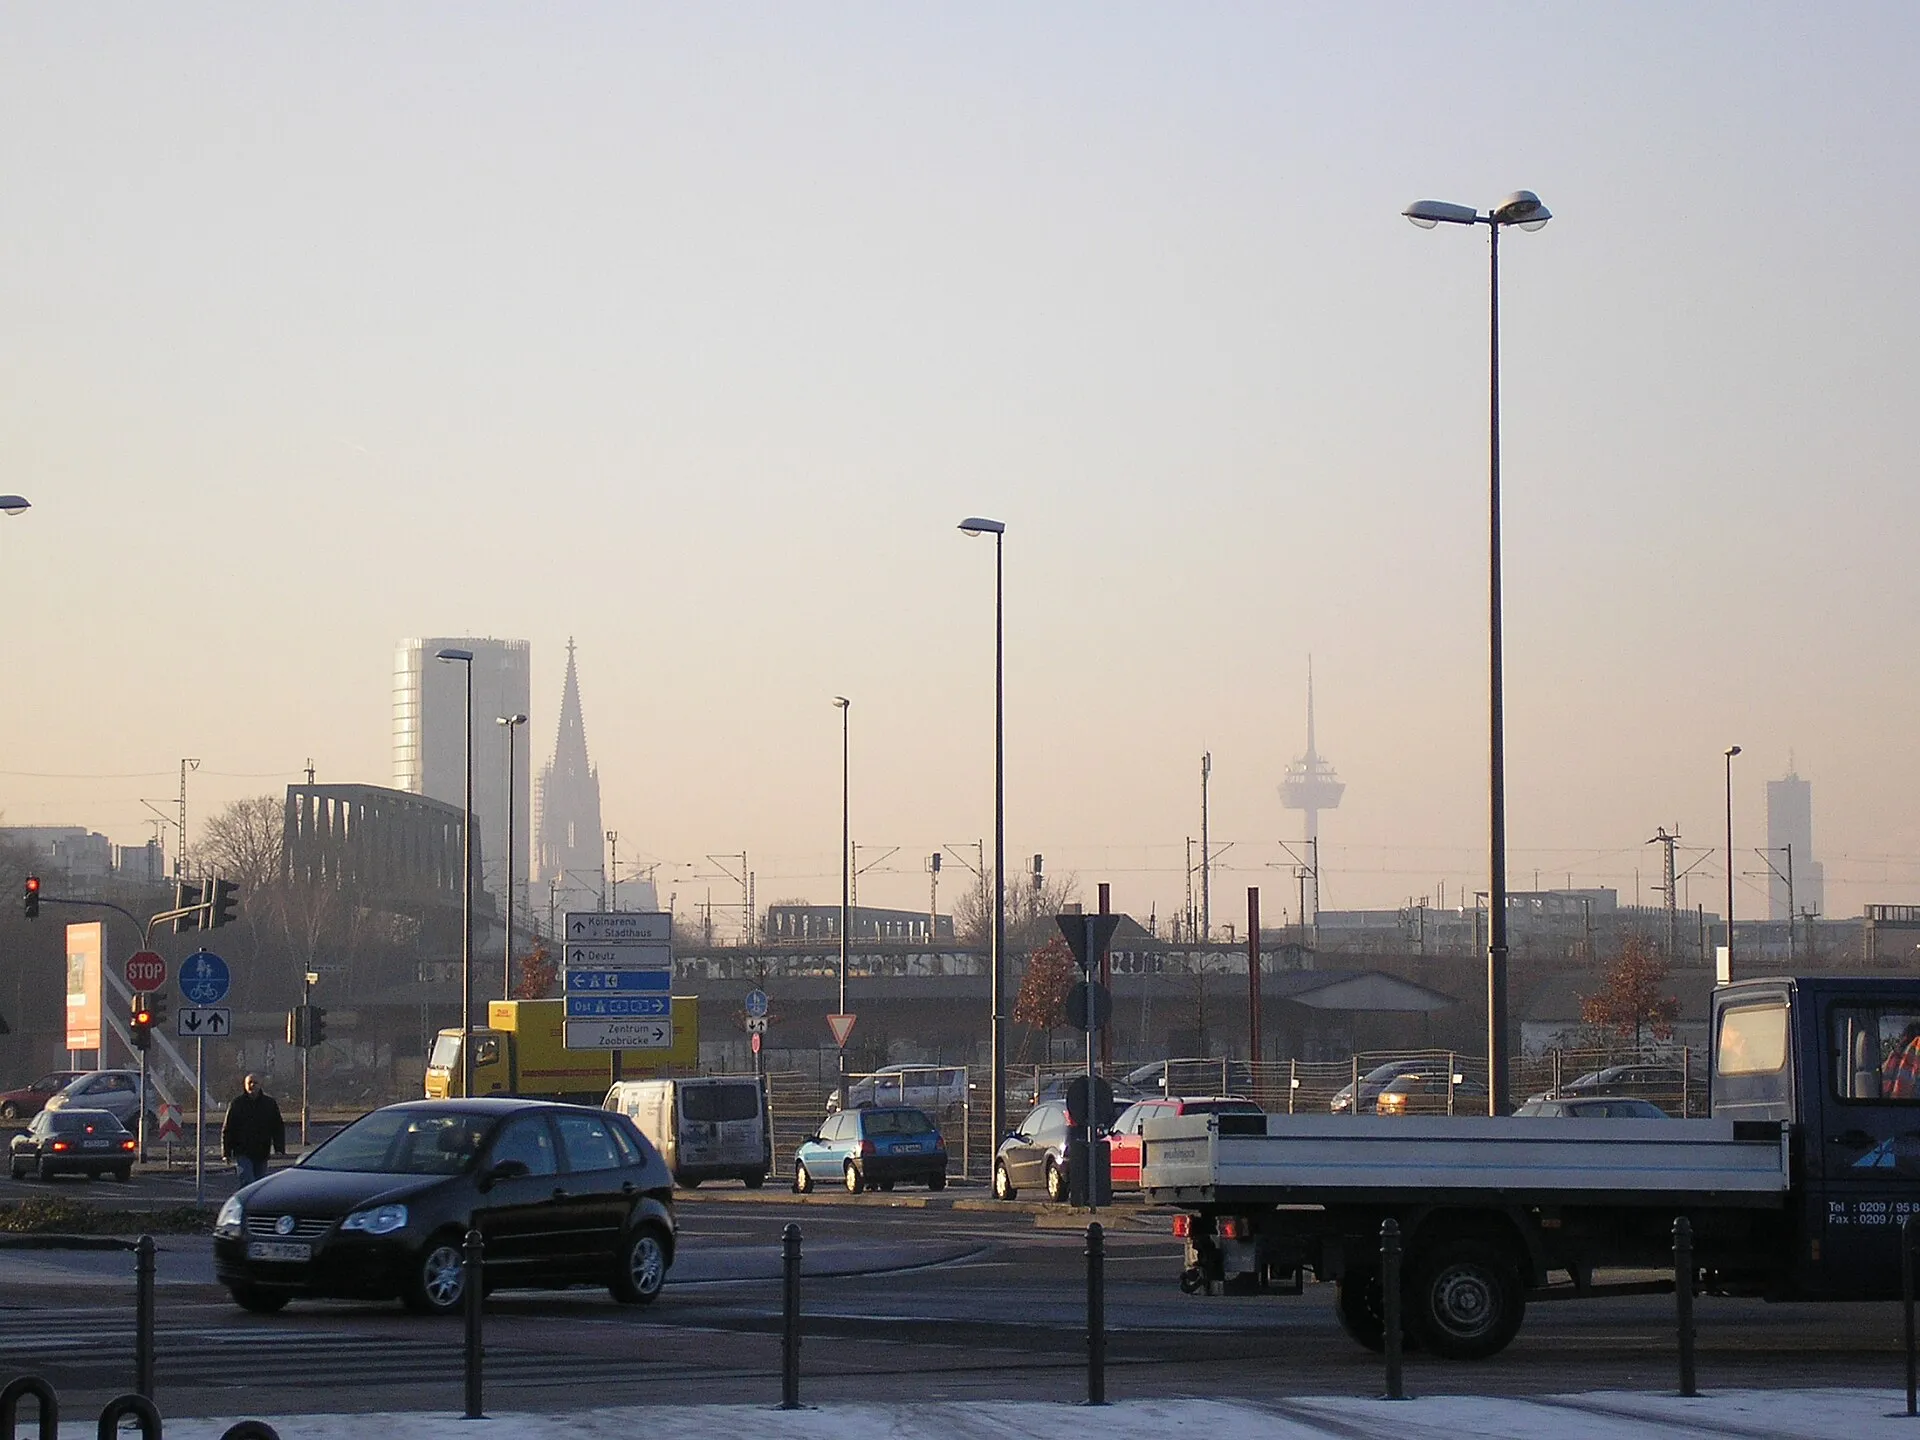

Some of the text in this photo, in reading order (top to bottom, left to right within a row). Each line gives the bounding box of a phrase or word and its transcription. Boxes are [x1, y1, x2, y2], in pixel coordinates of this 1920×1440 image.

[605, 928, 652, 938] Stadthaus
[588, 951, 616, 960] Deutz
[128, 962, 163, 980] STOP
[608, 1024, 649, 1034] Zentrum
[599, 1036, 649, 1045] Zoobrücke
[1828, 1201, 1845, 1212] Tel
[1859, 1202, 1886, 1212] 0209
[1896, 1202, 1910, 1213] 95
[1828, 1214, 1849, 1224] Fax
[1859, 1214, 1886, 1225] 0209
